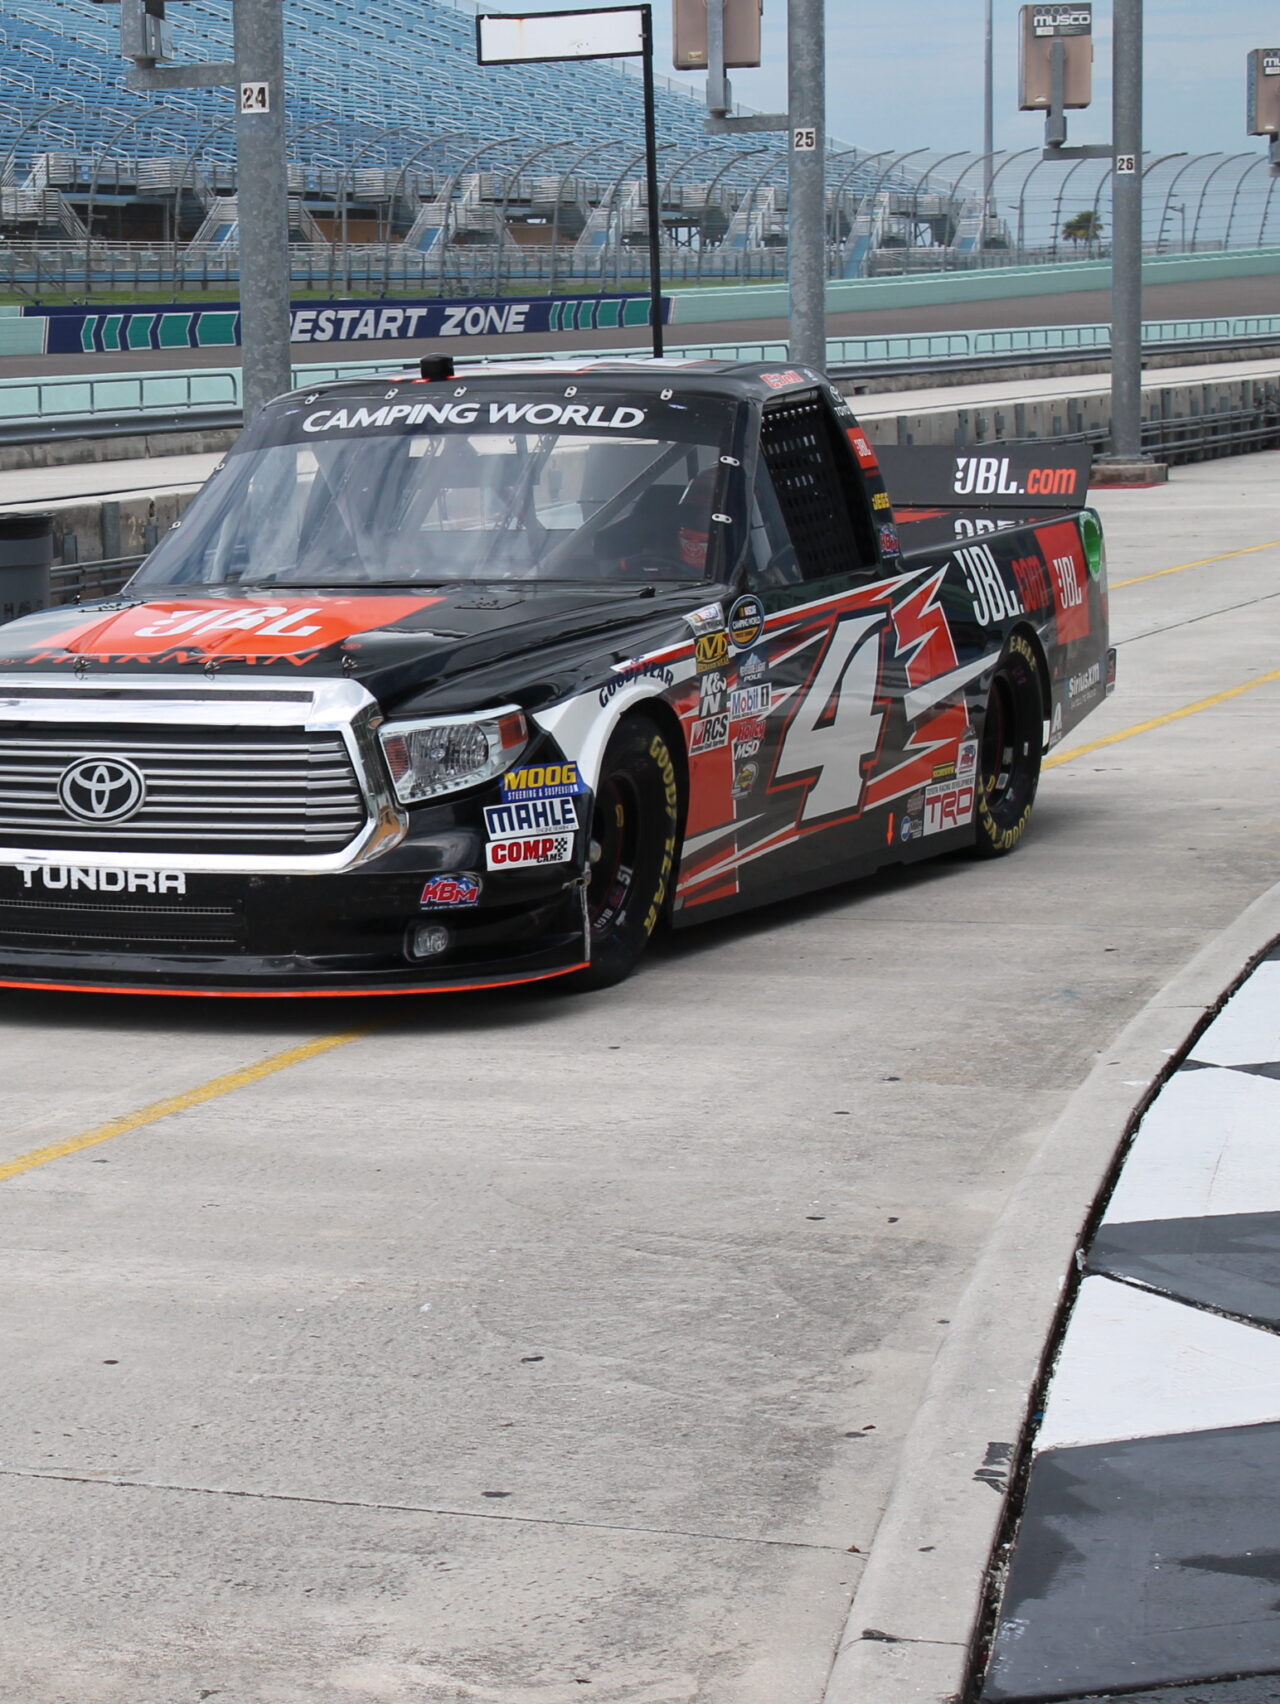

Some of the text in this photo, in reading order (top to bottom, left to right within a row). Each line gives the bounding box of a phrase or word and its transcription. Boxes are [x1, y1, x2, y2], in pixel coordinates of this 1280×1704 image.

[243, 87, 266, 108] 24
[795, 131, 815, 148] 25
[1118, 157, 1135, 171] 26
[289, 304, 530, 343] ESTART ZONE
[302, 403, 646, 432] CAMPING WORLD
[954, 457, 1078, 495] JBL.com
[1052, 555, 1083, 610] JBL
[133, 607, 323, 638] JBL
[1009, 635, 1037, 672] EAGLE
[744, 673, 762, 682] POLE
[732, 687, 760, 715] Mobil
[703, 714, 728, 743] RCS
[774, 611, 886, 822] 4
[735, 740, 760, 760] MSD
[503, 764, 577, 791] MOOG
[508, 789, 536, 800] STEERING
[925, 786, 974, 830] TRD
[486, 798, 576, 834] MAHLE
[491, 838, 554, 865] COMP
[537, 853, 564, 864] CAMS
[15, 864, 186, 894] TUNDRA
[420, 880, 478, 904] KBM
